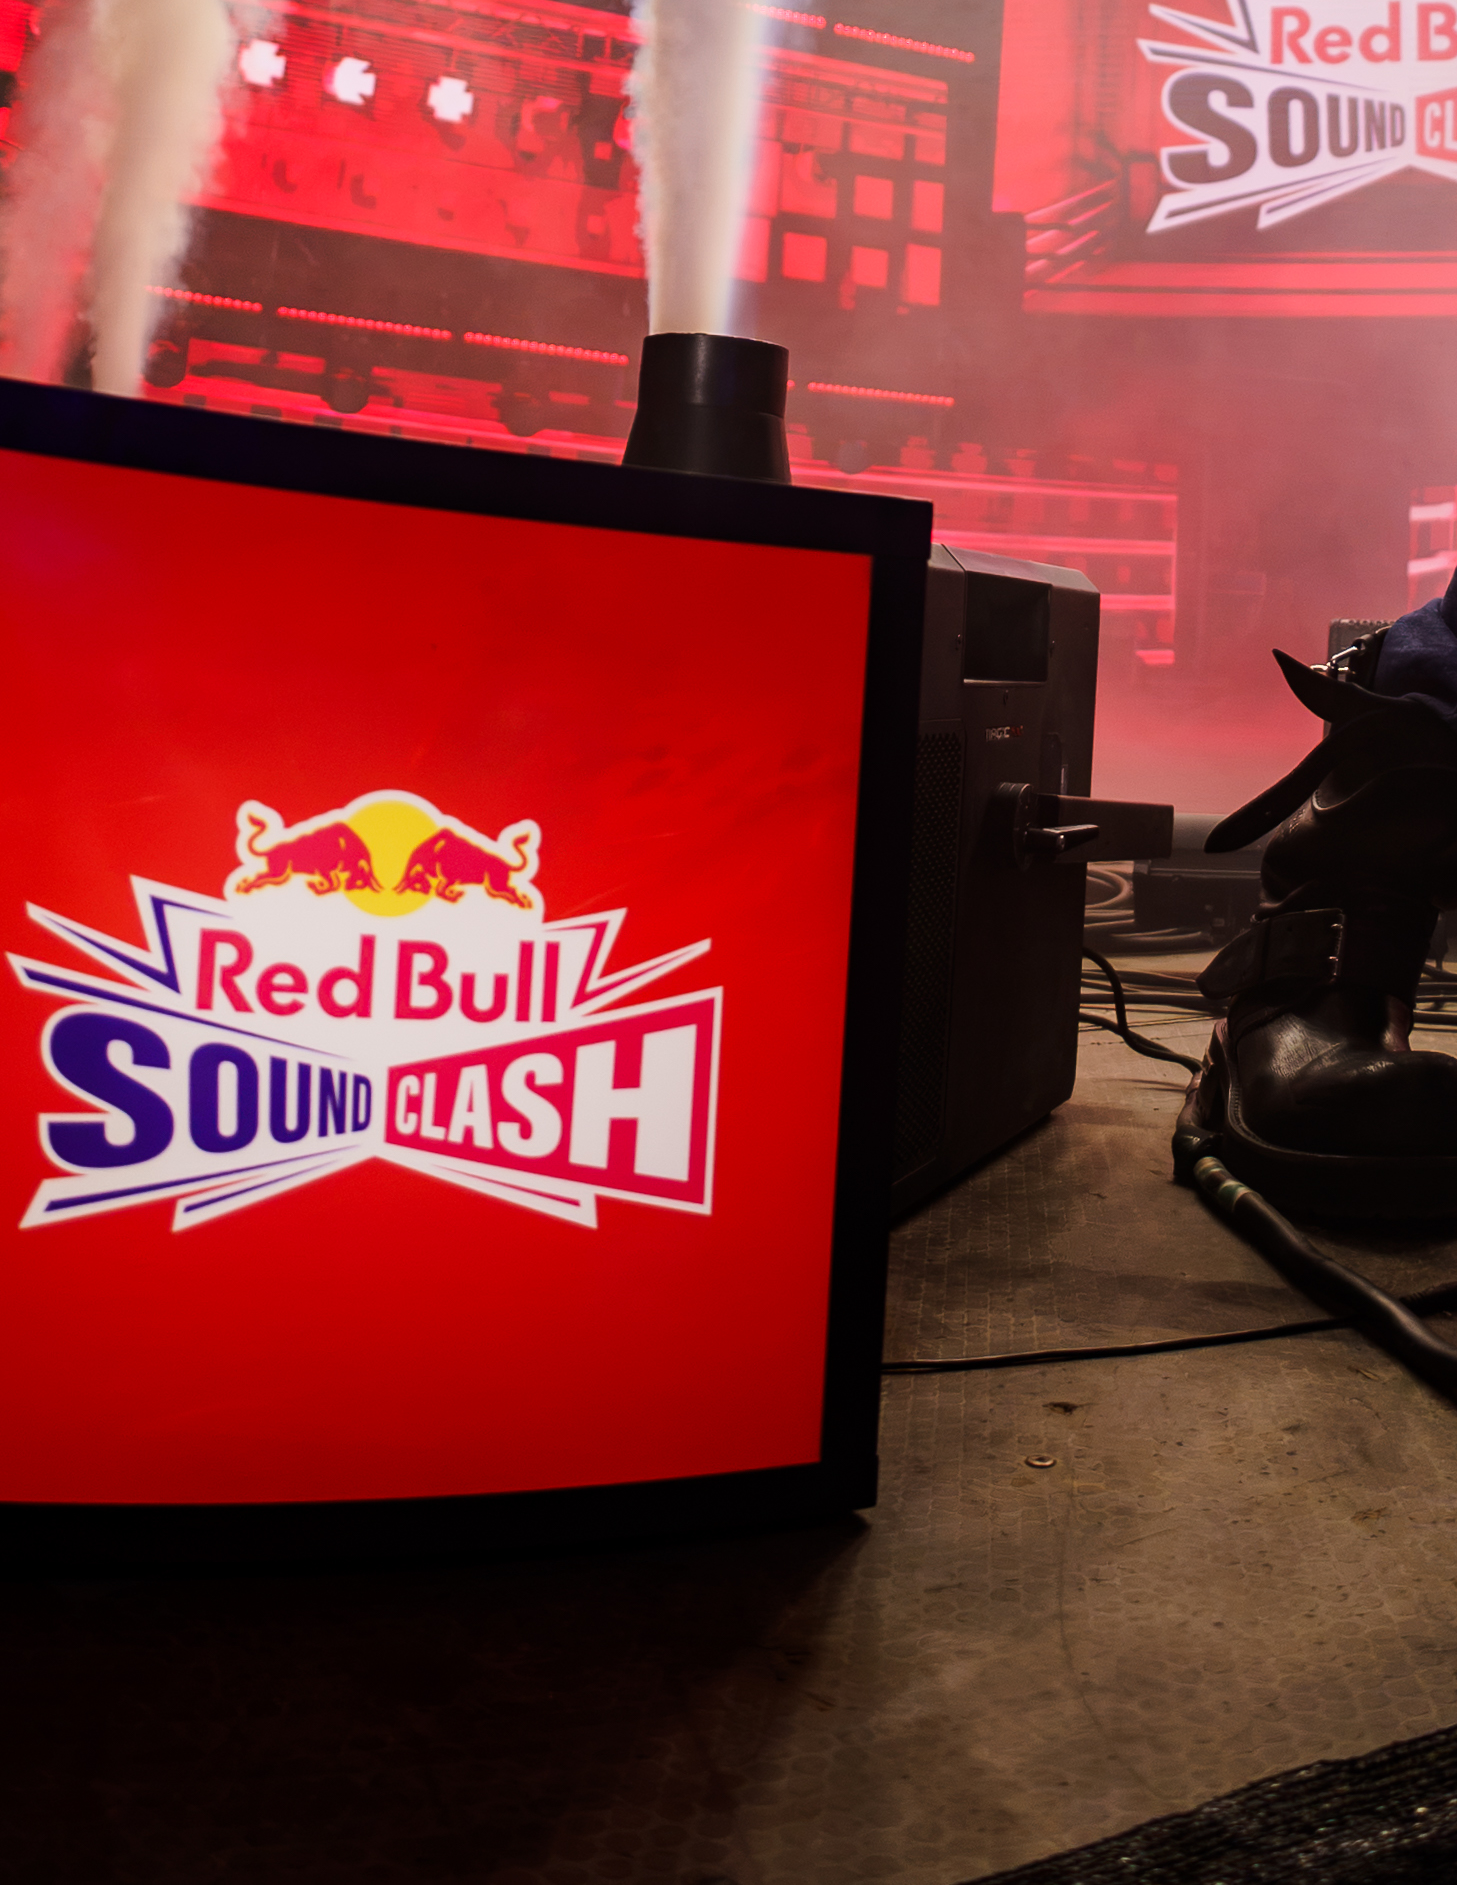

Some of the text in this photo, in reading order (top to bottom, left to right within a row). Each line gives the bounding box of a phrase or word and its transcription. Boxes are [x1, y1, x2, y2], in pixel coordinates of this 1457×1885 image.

[1270, 1, 1403, 65] Red
[1167, 71, 1406, 185] SOUND
[195, 927, 561, 1023] Red Bull
[47, 1011, 698, 1182] SOUND CLASH
